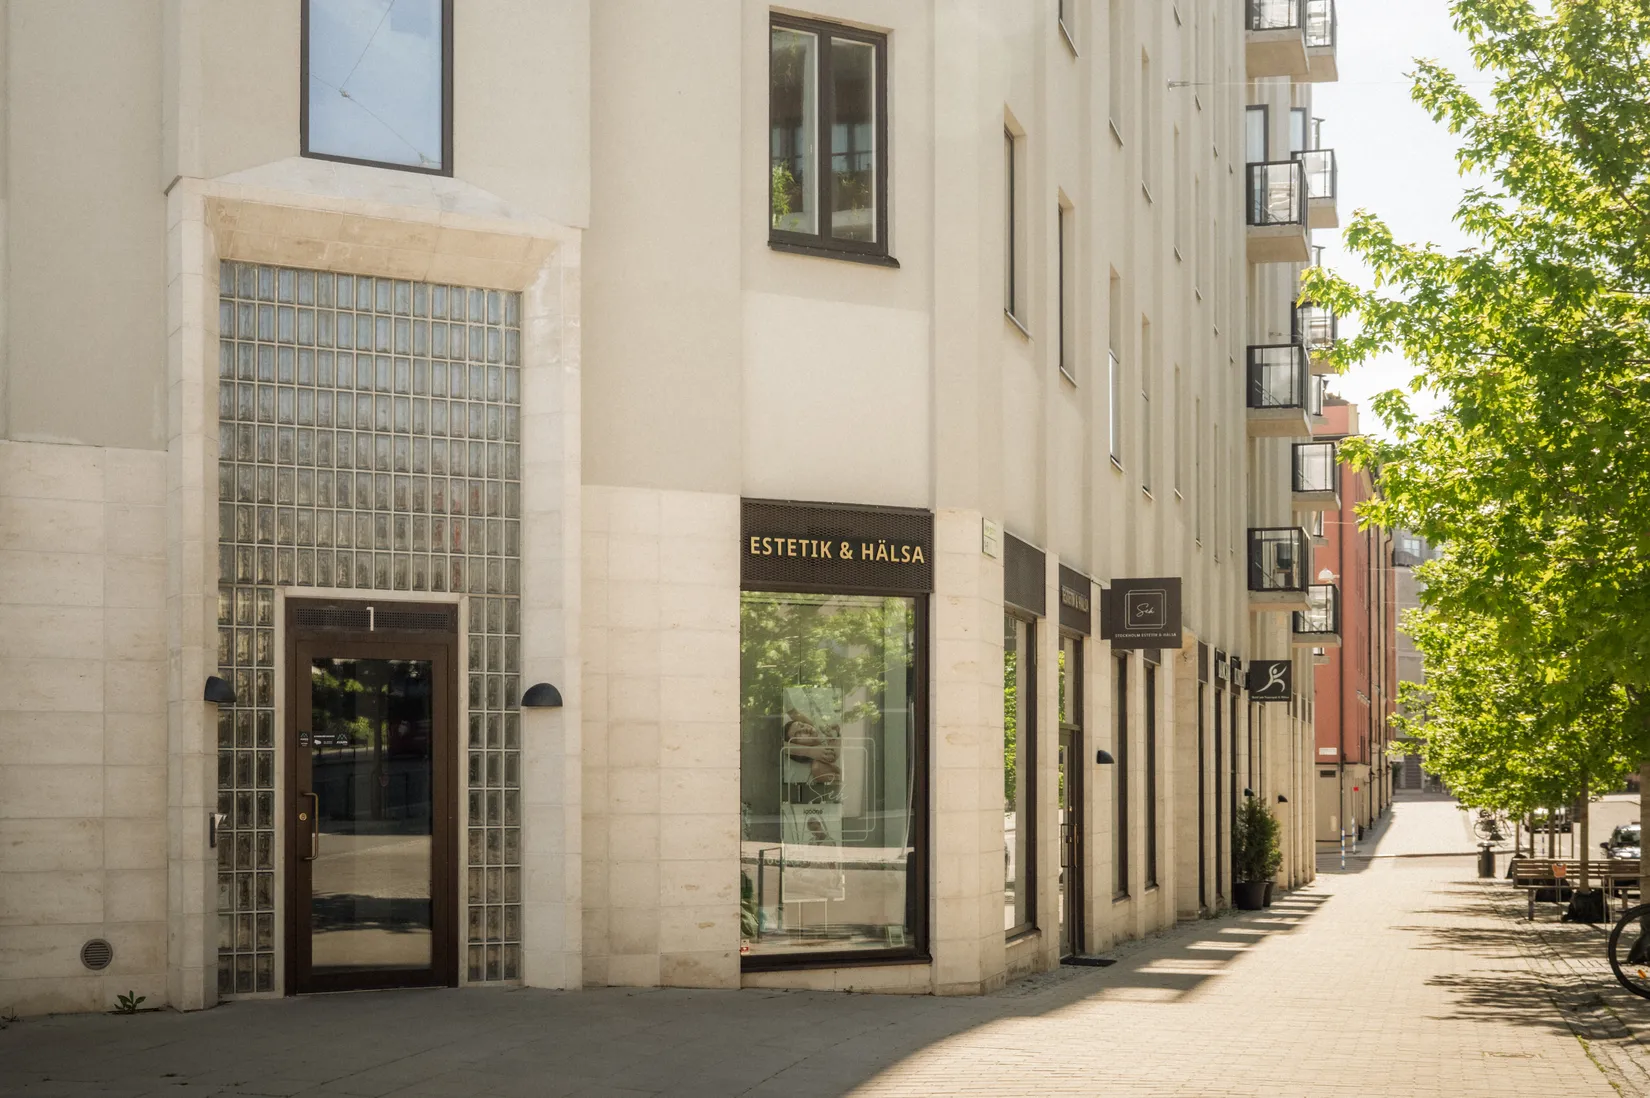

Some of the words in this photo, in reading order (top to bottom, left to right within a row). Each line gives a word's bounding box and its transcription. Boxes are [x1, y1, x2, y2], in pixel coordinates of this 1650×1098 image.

[750, 536, 832, 559] ESTETIK
[839, 541, 853, 560] &
[861, 539, 925, 564] HÄLSA
[366, 606, 375, 632] 1
